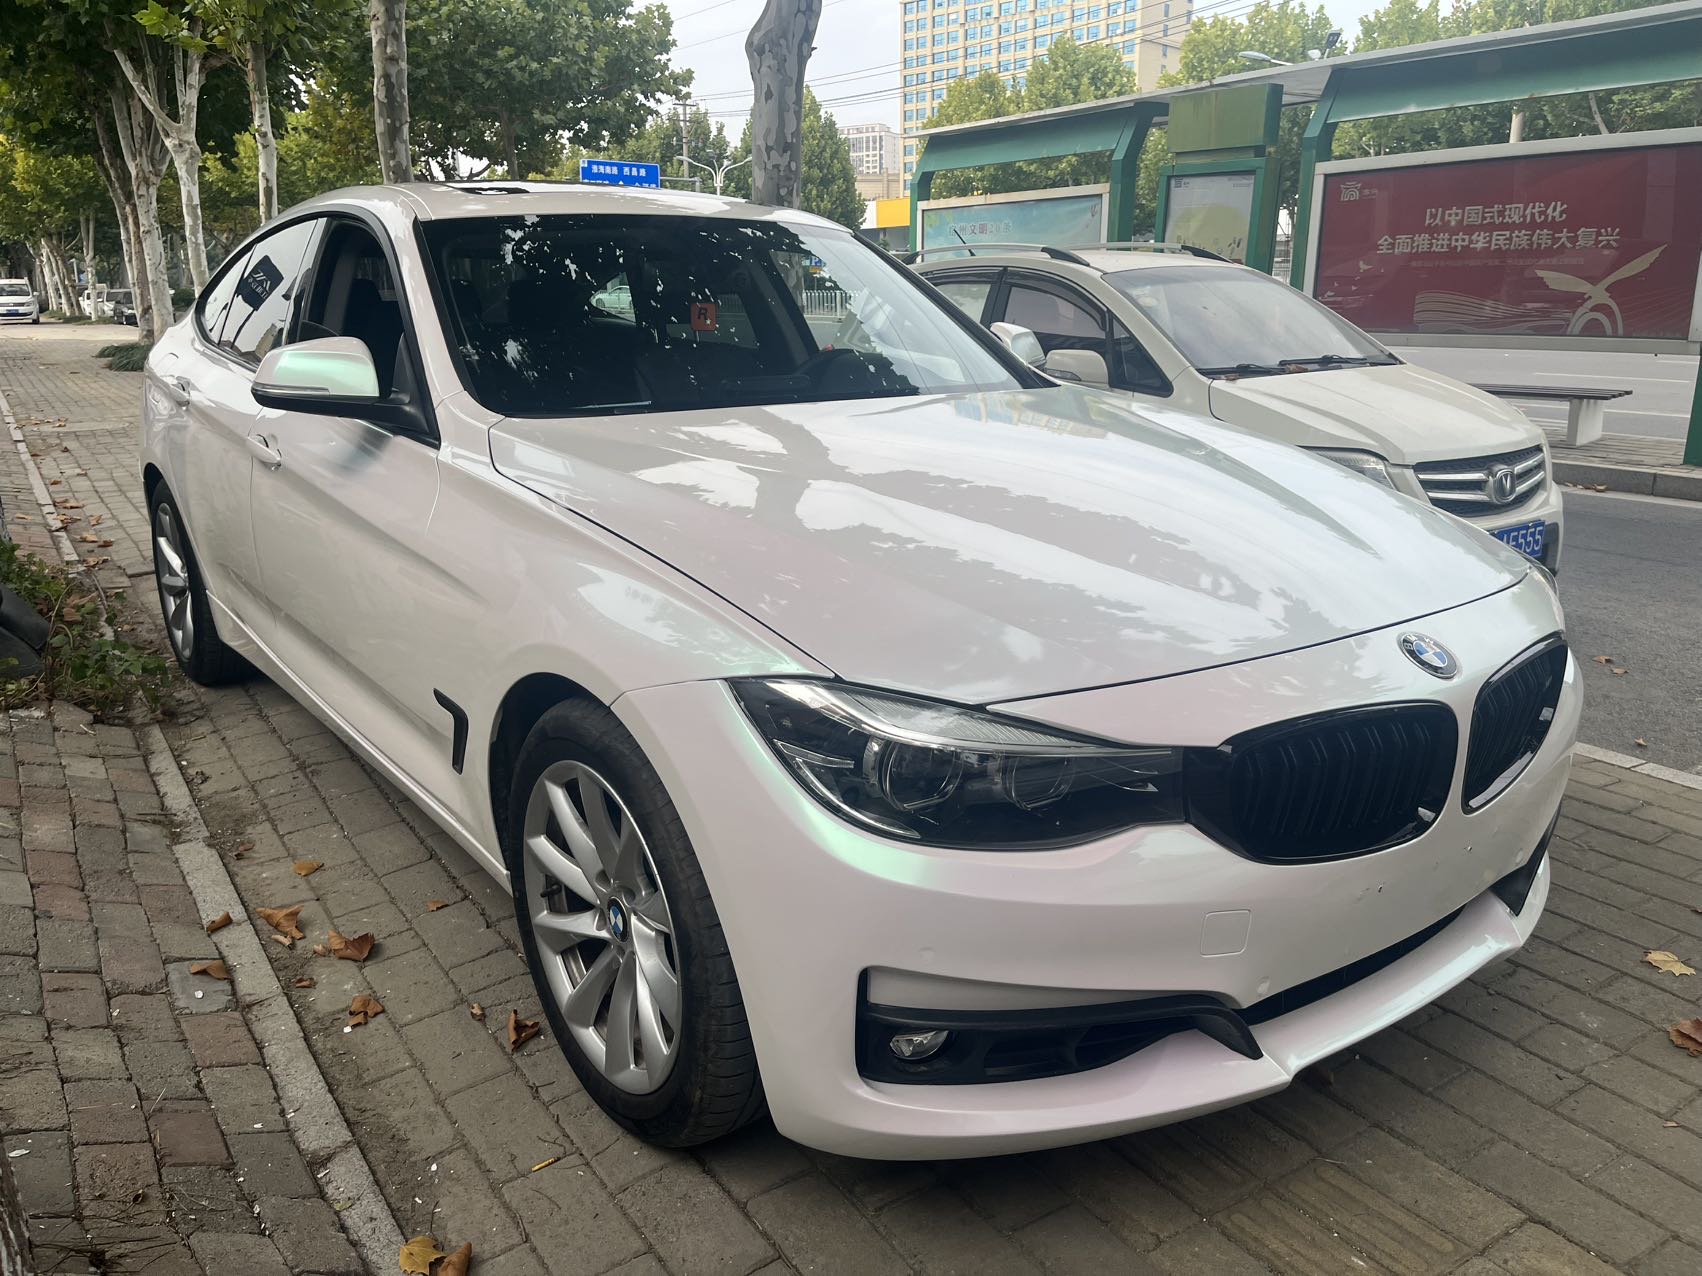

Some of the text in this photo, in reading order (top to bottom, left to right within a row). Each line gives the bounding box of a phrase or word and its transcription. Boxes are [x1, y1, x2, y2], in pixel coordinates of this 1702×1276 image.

[1425, 201, 1568, 227] 以中国式现代化
[1376, 227, 1620, 254] 全面推进中华民族伟大复兴
